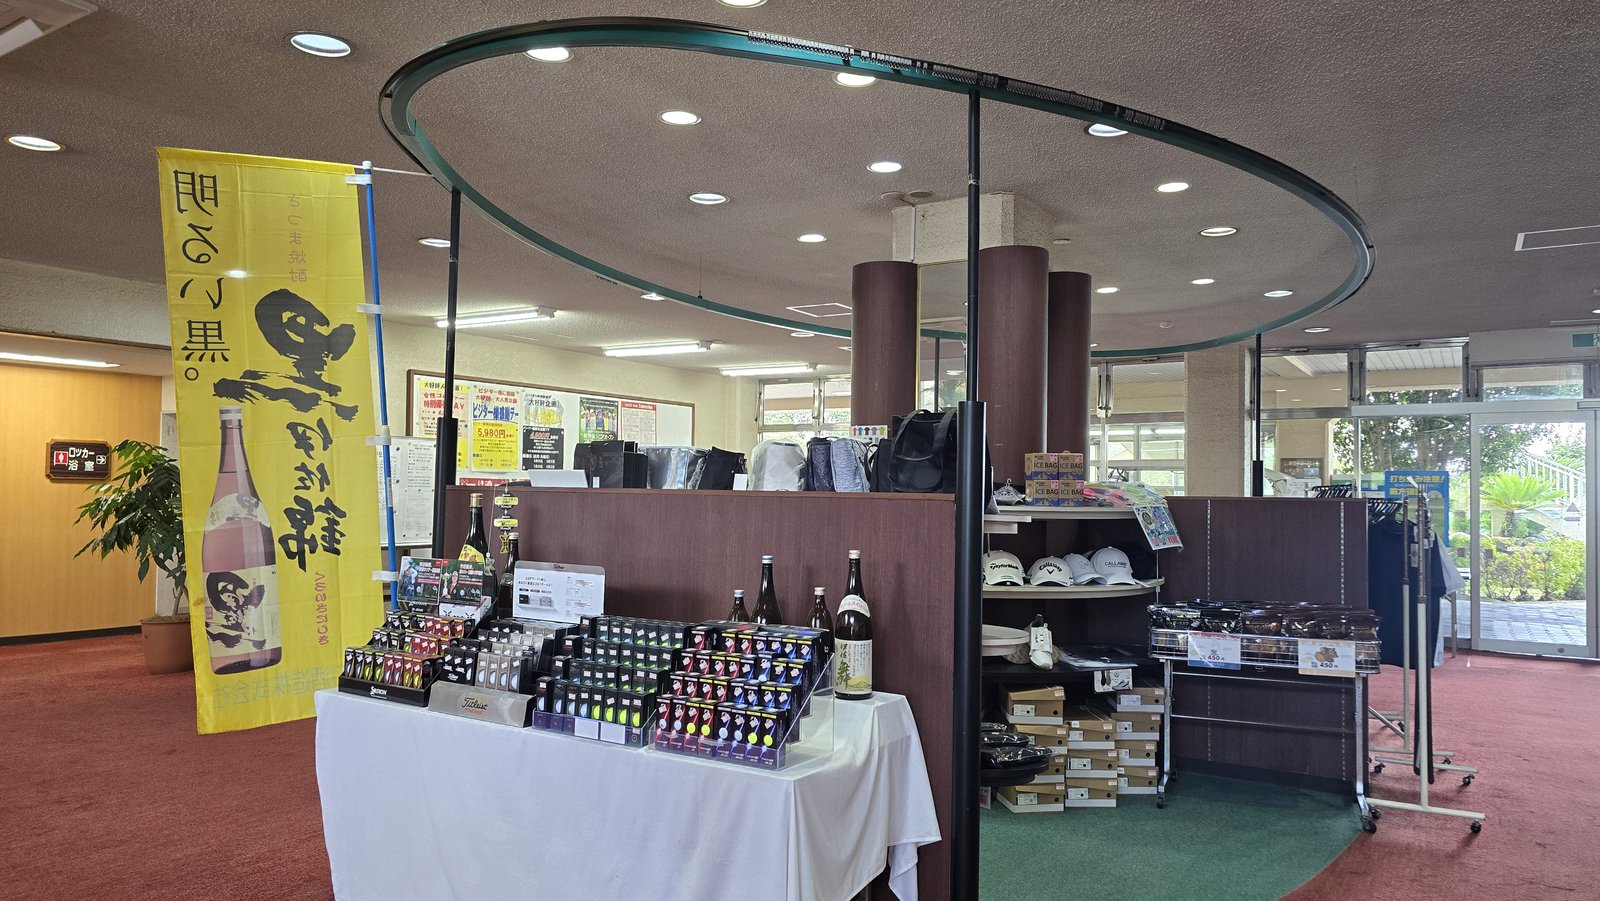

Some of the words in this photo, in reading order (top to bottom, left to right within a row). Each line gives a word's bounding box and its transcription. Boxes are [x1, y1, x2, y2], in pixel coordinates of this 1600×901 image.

[478, 428, 506, 438] 5,980円
[68, 447, 95, 458] ロッカー
[68, 460, 95, 471] 浴室
[1039, 562, 1062, 572] Callaway
[462, 697, 488, 710] Titleist
